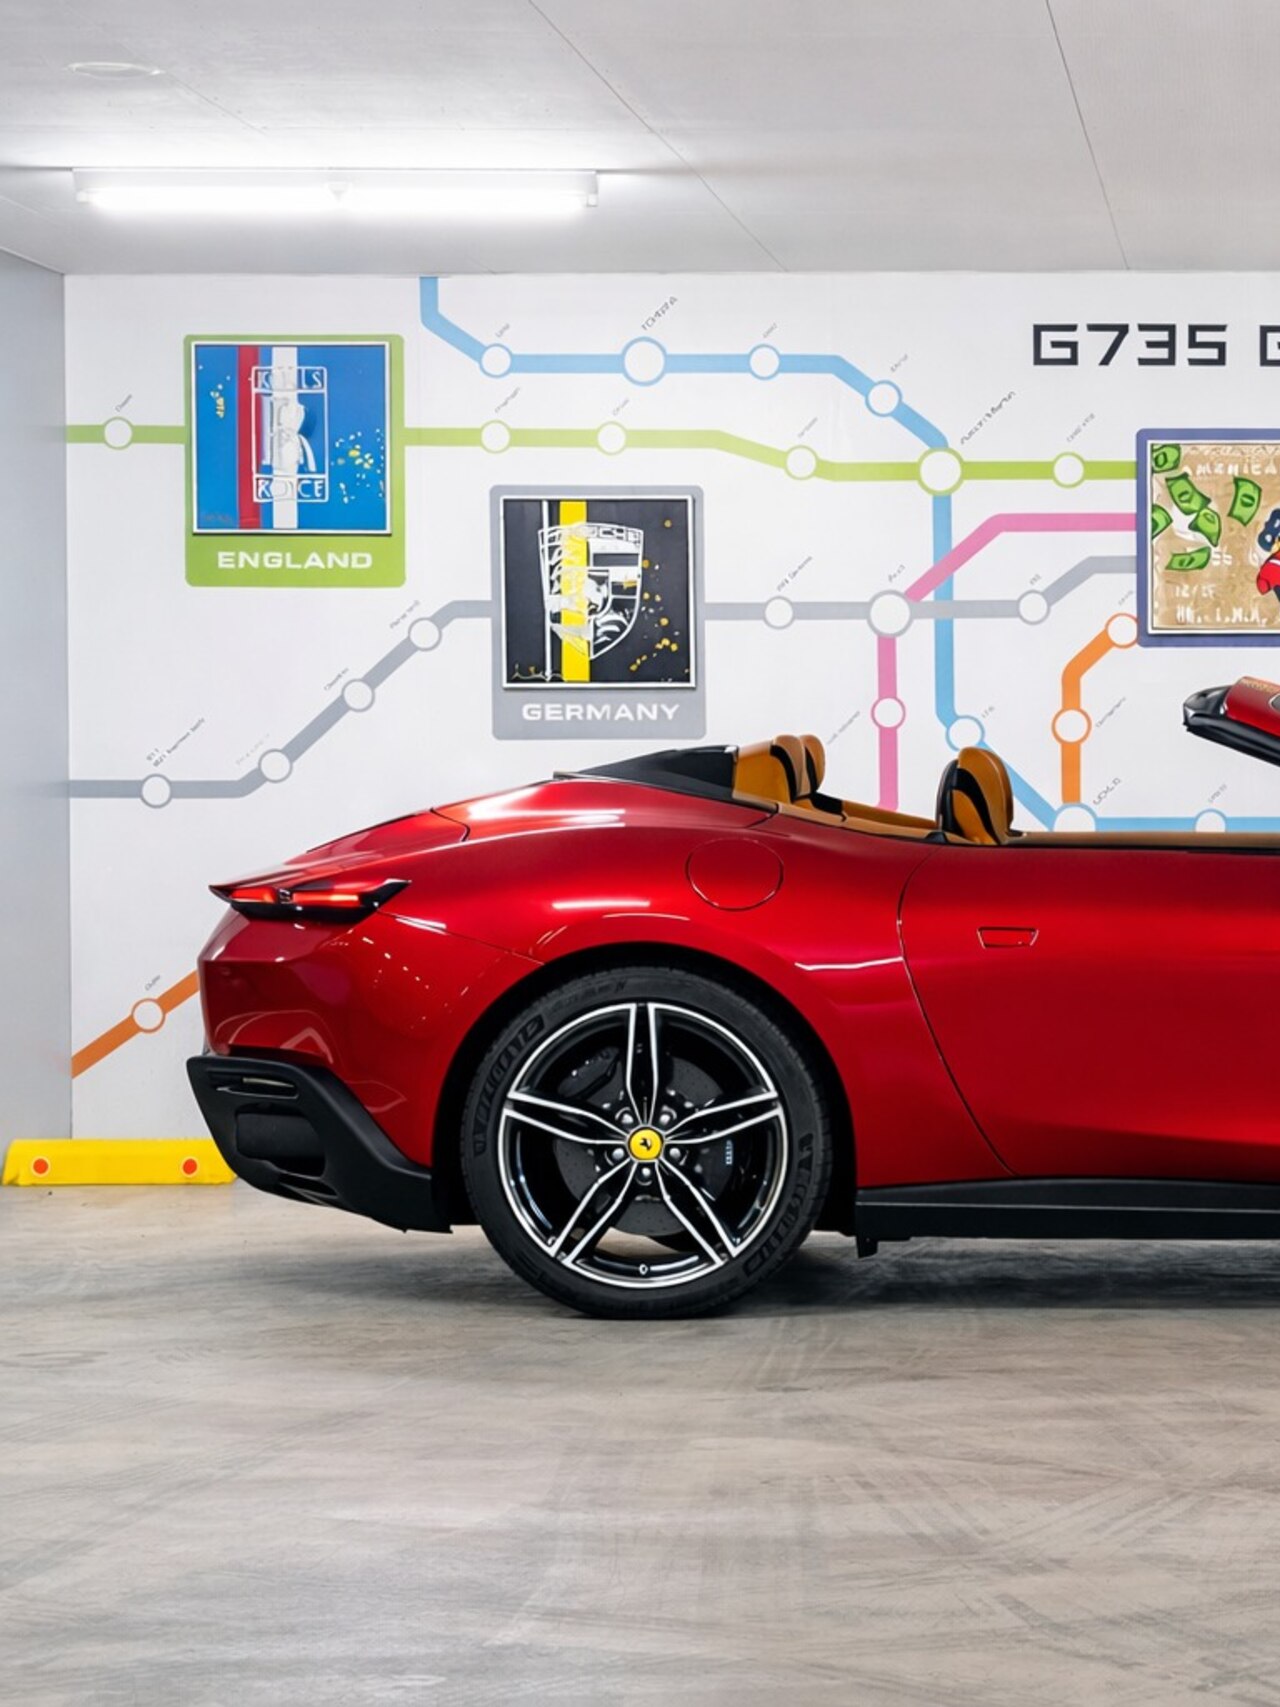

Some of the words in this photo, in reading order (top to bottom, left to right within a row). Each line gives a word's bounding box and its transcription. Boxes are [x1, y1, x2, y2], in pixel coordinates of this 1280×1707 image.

[1033, 323, 1228, 366] G735
[257, 370, 323, 390] RLS
[217, 551, 373, 570] ENGLAND
[521, 703, 680, 721] GERMANY
